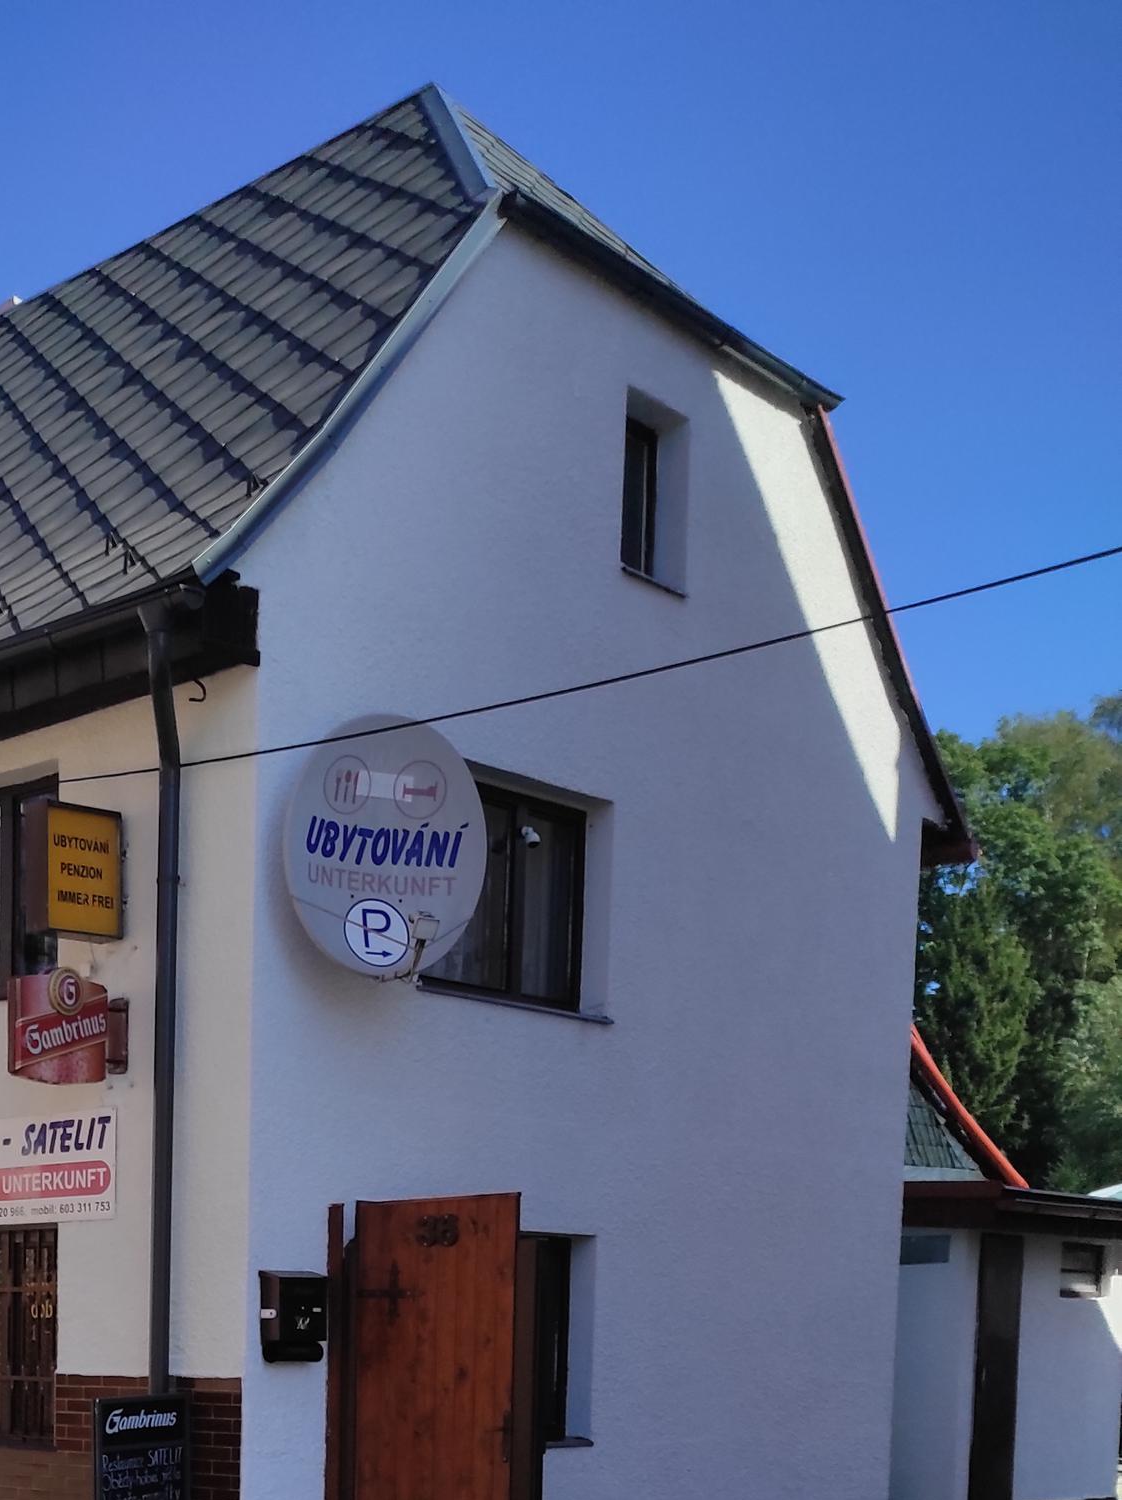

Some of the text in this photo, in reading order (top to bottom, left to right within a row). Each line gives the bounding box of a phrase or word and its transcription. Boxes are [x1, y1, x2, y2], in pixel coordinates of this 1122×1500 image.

[306, 816, 469, 868] UBYTOVÁNÍ
[60, 862, 103, 880] PENZION
[308, 862, 457, 896] UNTERKUNFT
[57, 890, 114, 909] IMMER FREI
[361, 908, 391, 948] P
[25, 1013, 107, 1055] Gambrinus
[21, 1116, 111, 1156] SATELIT
[2, 1168, 107, 1193] UNTERKUNFT
[31, 1204, 57, 1216] mobil:
[59, 1203, 75, 1214] 603
[77, 1202, 92, 1213] 311
[95, 1201, 111, 1212] 753
[105, 1408, 177, 1434] Gambrinus
[147, 1446, 183, 1467] SATELIT
